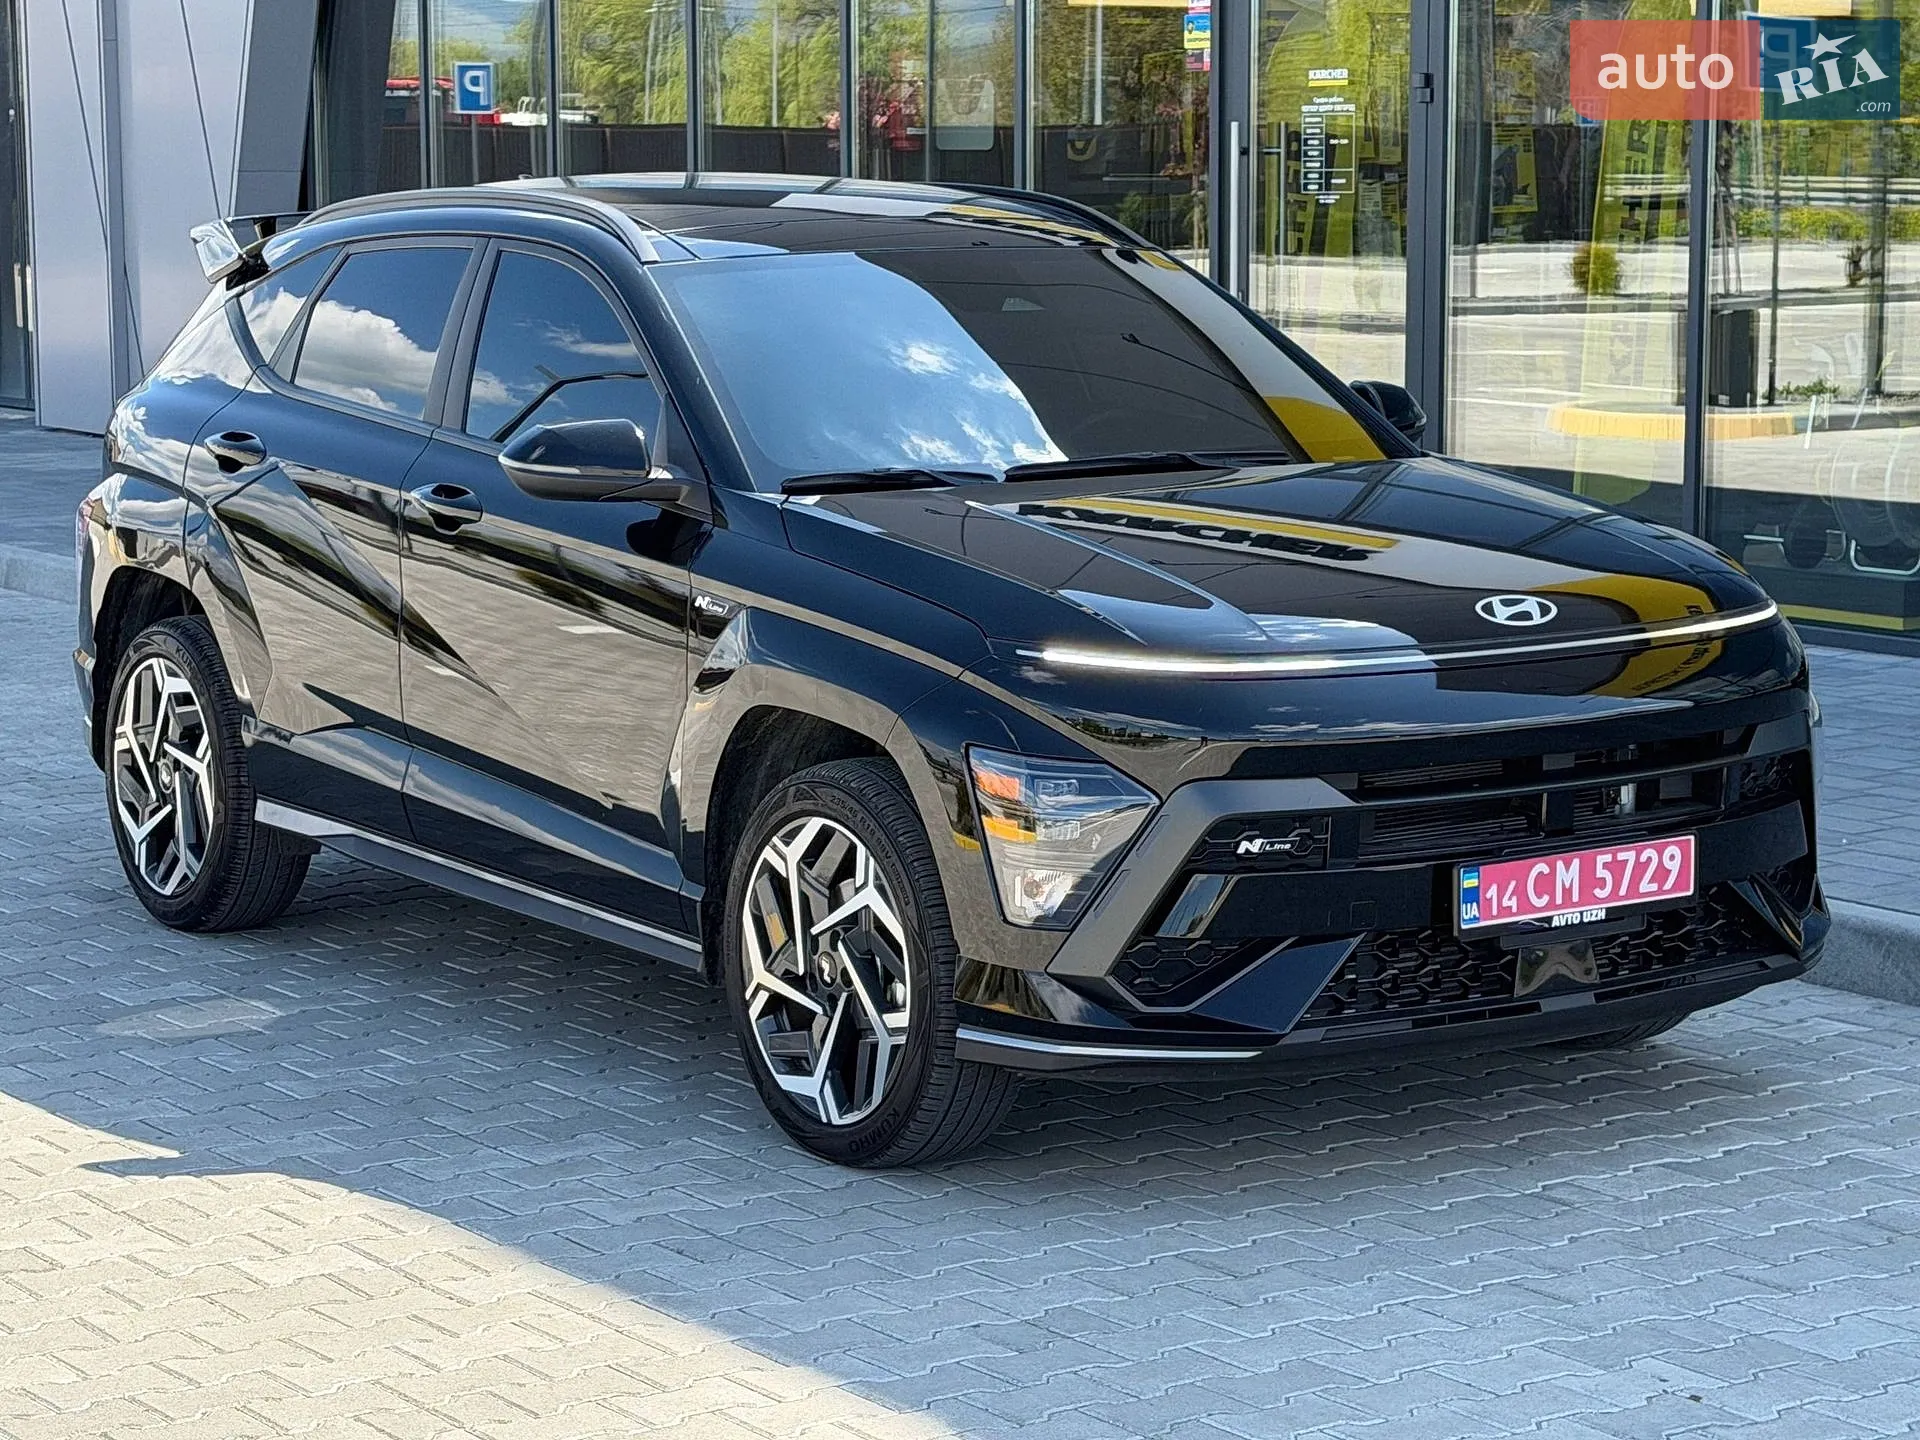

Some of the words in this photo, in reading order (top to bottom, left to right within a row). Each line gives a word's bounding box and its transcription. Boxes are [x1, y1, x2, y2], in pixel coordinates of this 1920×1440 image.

[694, 595, 711, 610] N
[1236, 838, 1263, 854] N
[1264, 842, 1292, 851] Line
[1485, 879, 1518, 917] 14
[1526, 857, 1580, 908] CM
[1592, 845, 1683, 899] 5729
[1462, 902, 1480, 919] UA
[1551, 911, 1581, 928] AVTO
[1582, 908, 1607, 923] UZH
